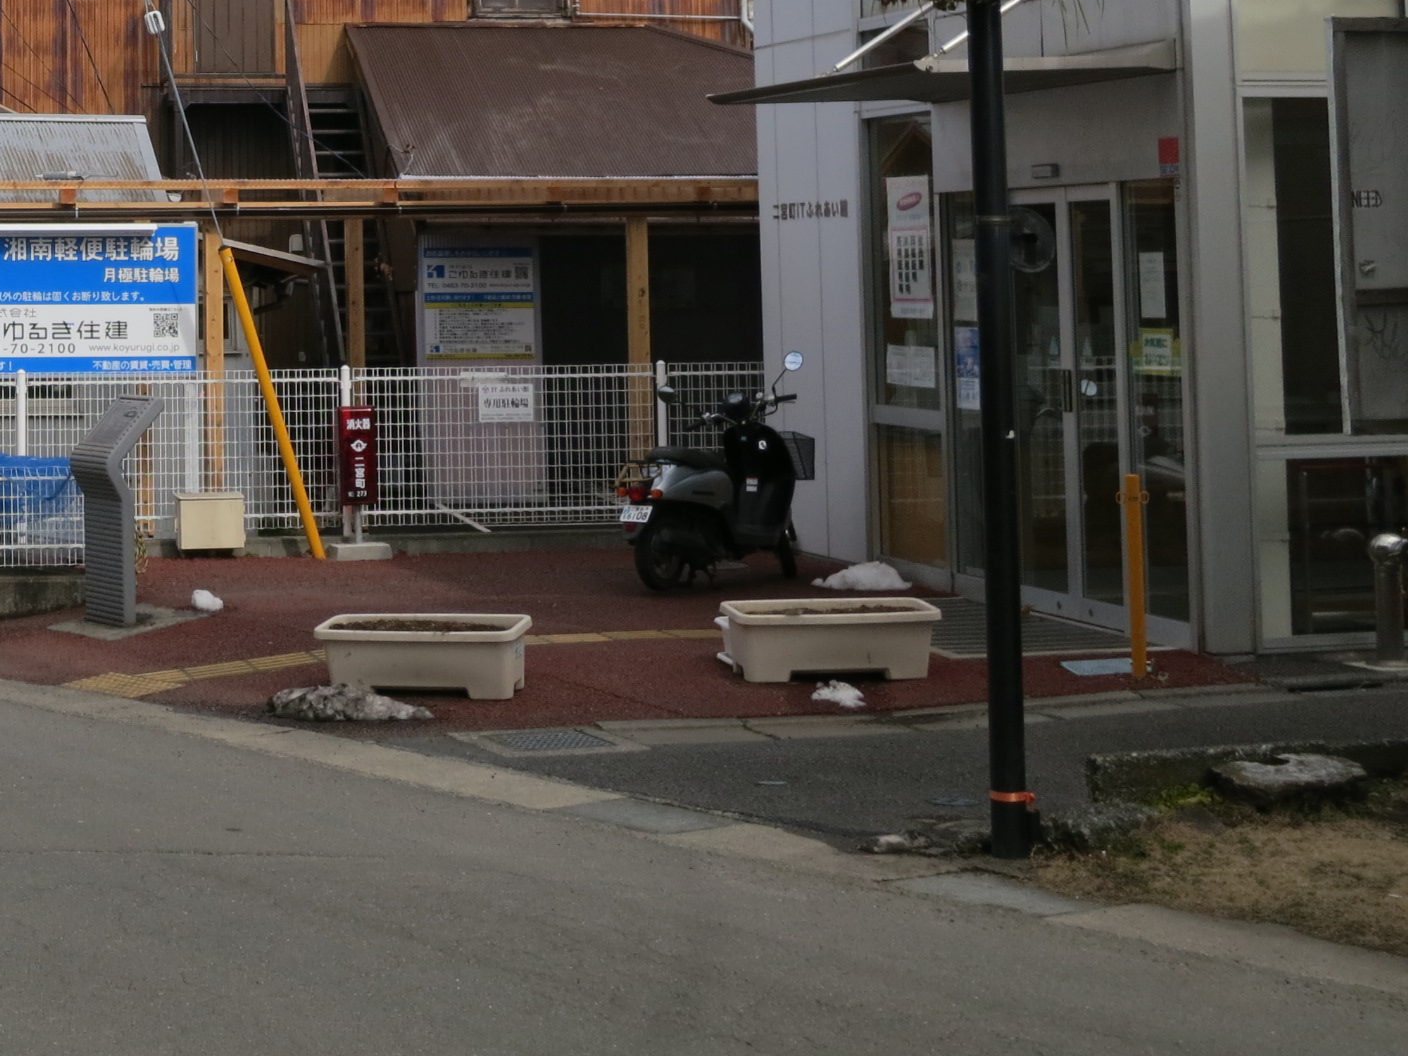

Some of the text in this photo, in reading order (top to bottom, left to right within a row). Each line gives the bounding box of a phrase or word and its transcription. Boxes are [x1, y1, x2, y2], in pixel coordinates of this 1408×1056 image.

[3, 236, 180, 262] 湘南軽便駐輪場
[103, 267, 180, 283] 月極駐輪場
[88, 342, 180, 354] www.koyurugi.co.jp
[483, 398, 529, 409] 専用駐輪場
[346, 418, 371, 430] 消火器
[354, 456, 366, 489] 二宮町
[356, 490, 367, 498] 273
